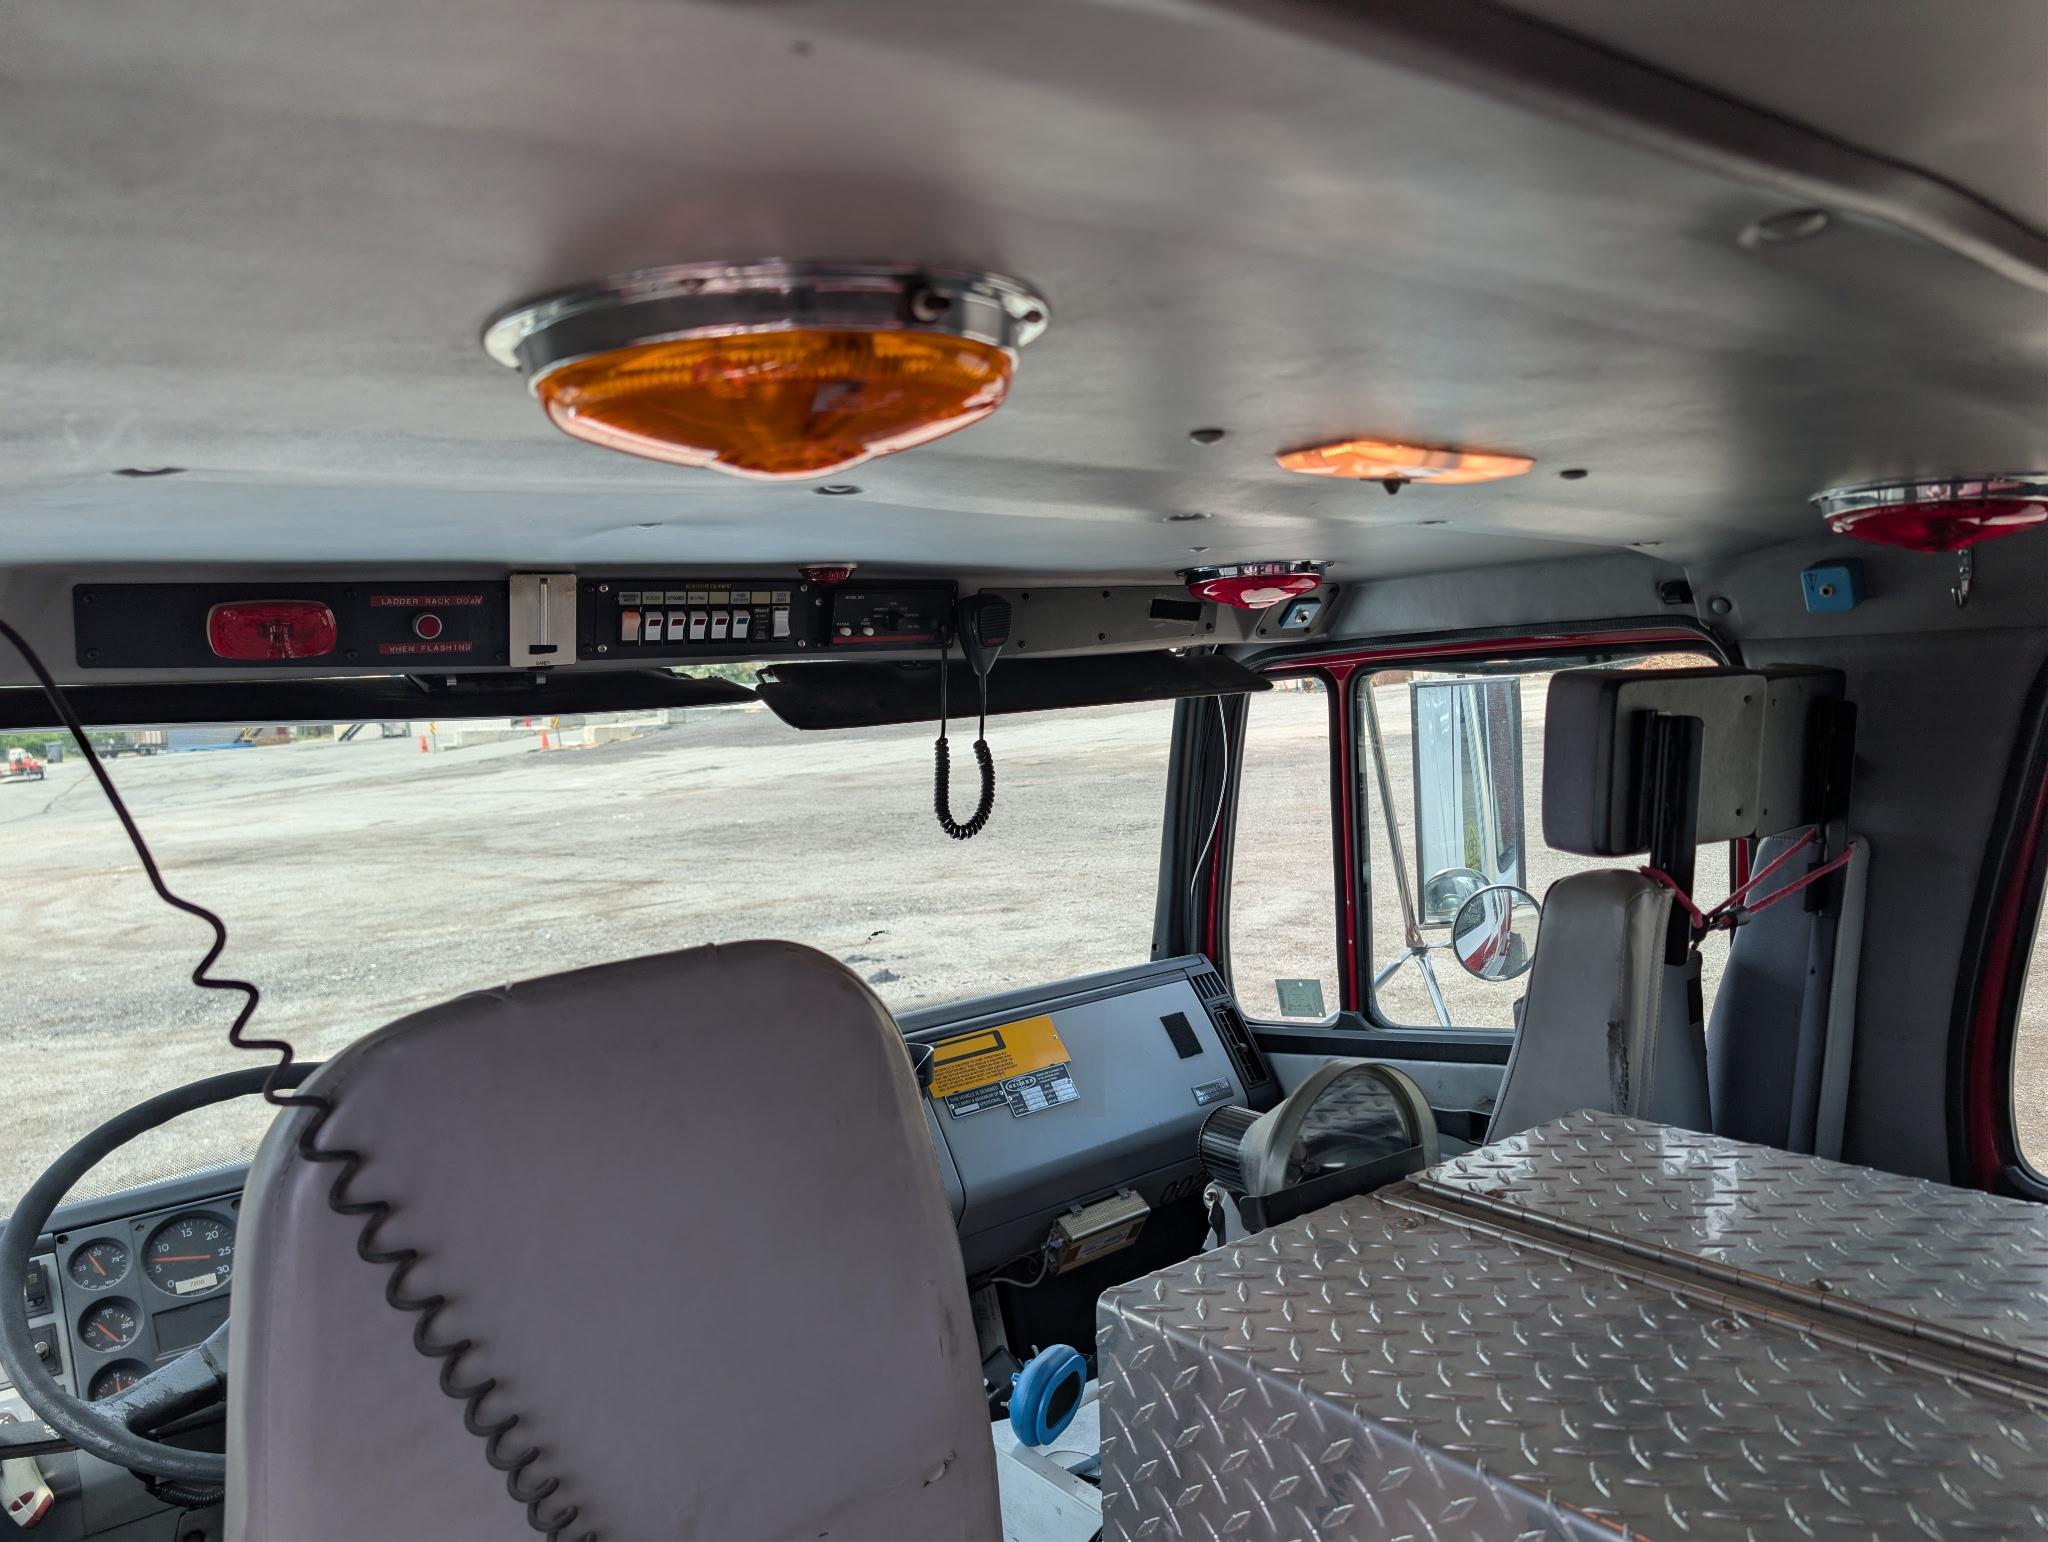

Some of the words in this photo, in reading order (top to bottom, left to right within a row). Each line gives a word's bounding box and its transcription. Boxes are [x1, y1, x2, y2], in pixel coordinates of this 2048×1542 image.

[381, 598, 419, 606] LADDER
[425, 597, 451, 605] RACK
[421, 644, 472, 653] FLASHING
[181, 1228, 193, 1238] 15
[205, 1230, 219, 1241] 20
[157, 1243, 170, 1253] 10
[218, 1246, 231, 1257] 25
[78, 1264, 87, 1272] 25
[155, 1264, 162, 1273] 5
[216, 1265, 230, 1275] 30
[167, 1280, 175, 1288] 0
